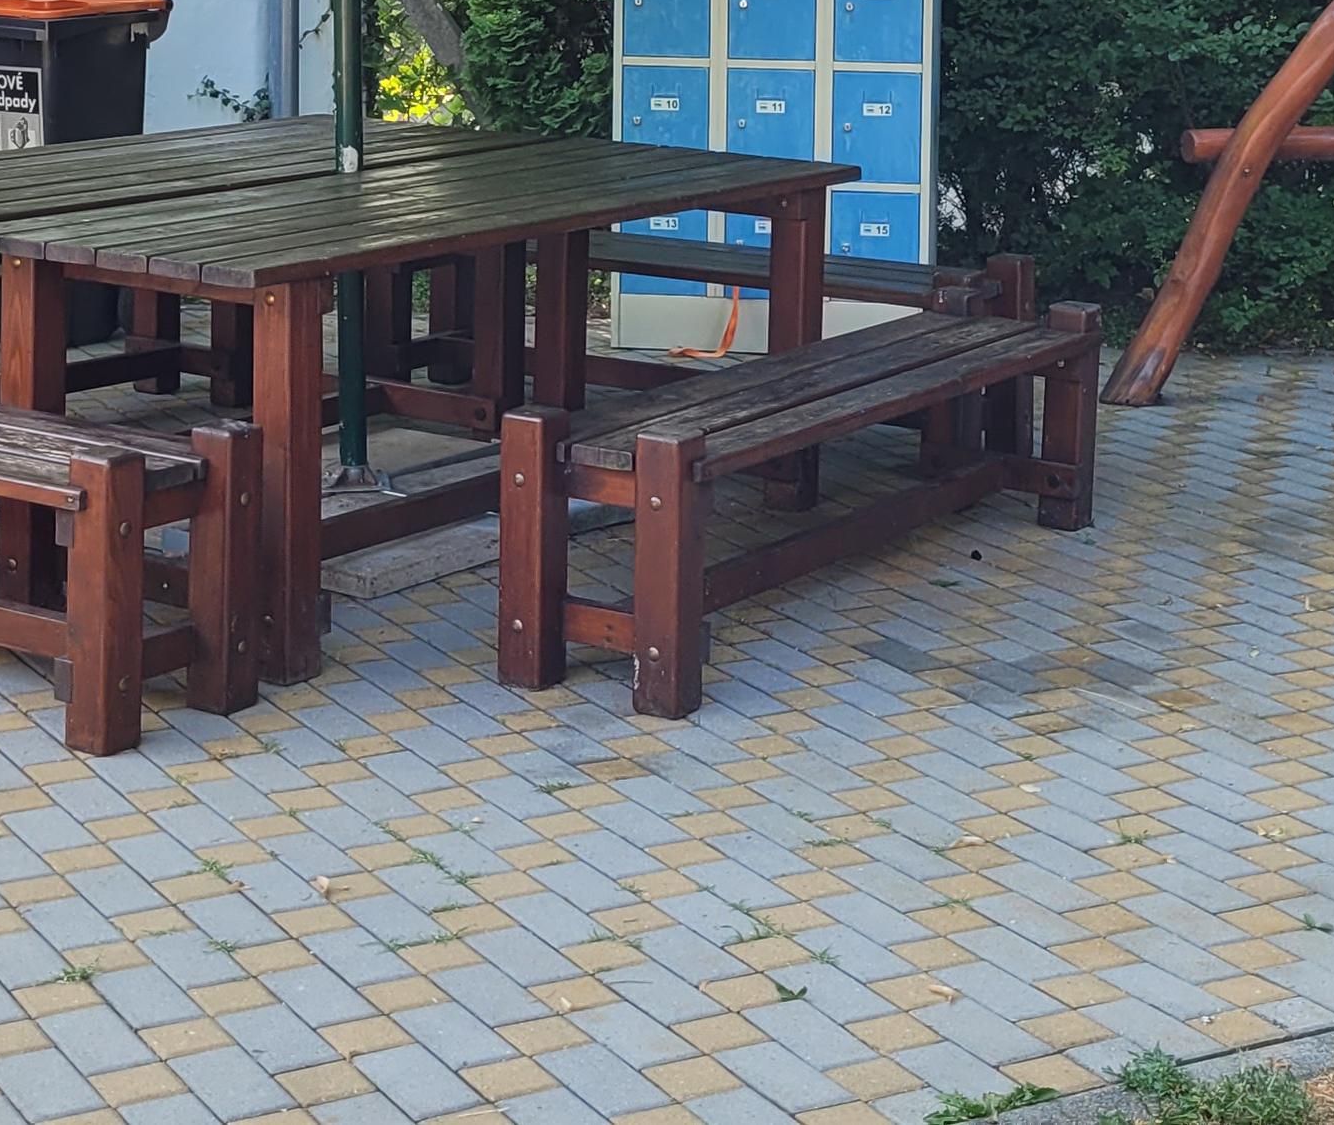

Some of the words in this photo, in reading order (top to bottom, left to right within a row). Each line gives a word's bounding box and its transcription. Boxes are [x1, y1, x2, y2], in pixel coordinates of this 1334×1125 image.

[666, 99, 678, 109] 10
[772, 102, 783, 112] 11
[878, 104, 890, 114] 12
[666, 218, 677, 228] 13
[875, 225, 888, 235] 15
